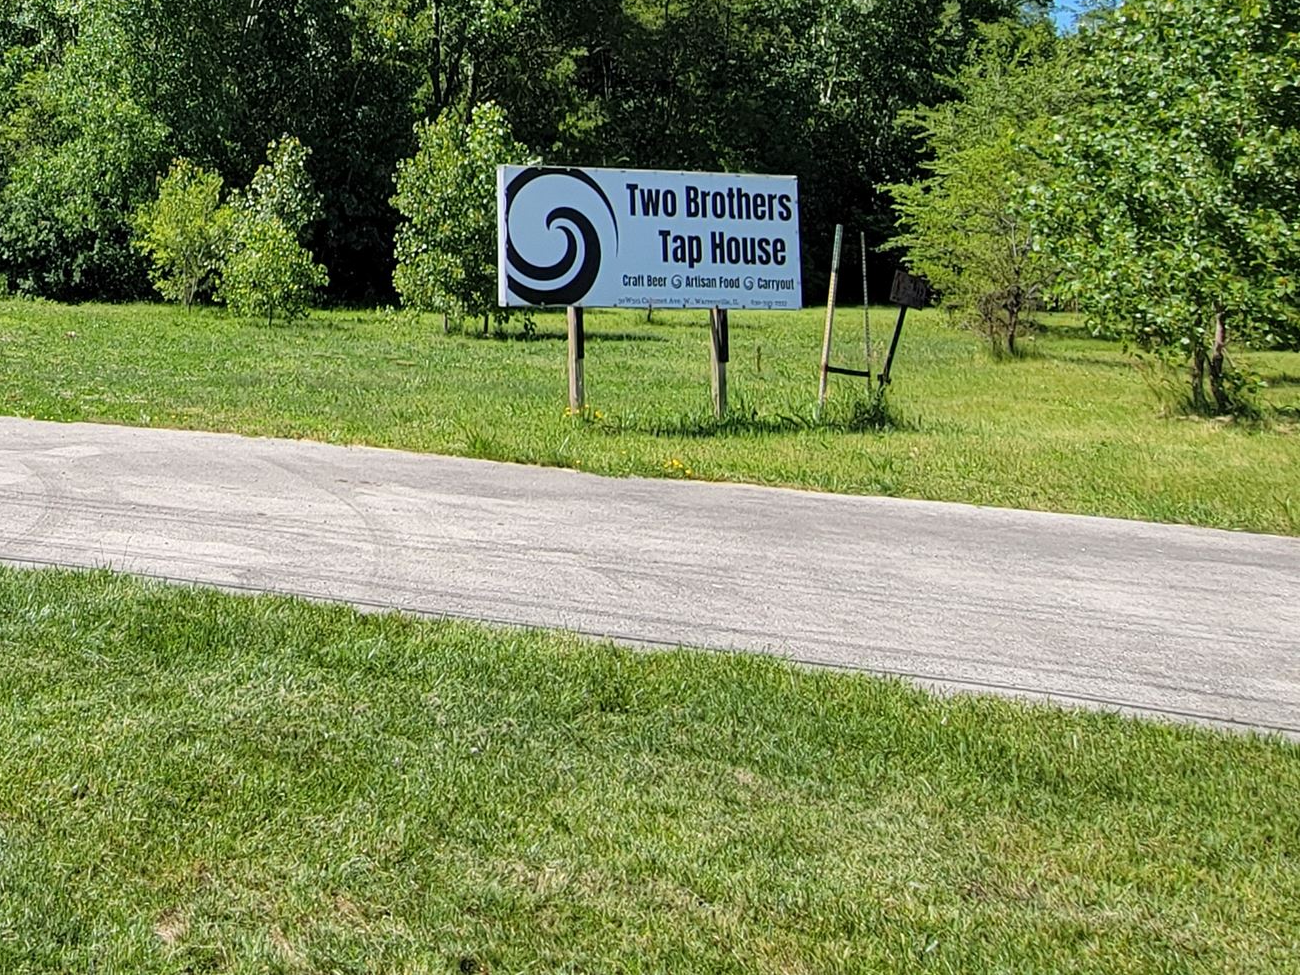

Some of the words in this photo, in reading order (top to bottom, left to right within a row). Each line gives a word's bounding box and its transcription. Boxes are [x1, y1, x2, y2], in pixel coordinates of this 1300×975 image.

[626, 183, 677, 218] Two
[685, 185, 792, 222] Brothers
[658, 230, 702, 269] Tap
[710, 231, 787, 266] House
[622, 274, 645, 287] Craft
[647, 275, 667, 287] Beer
[685, 276, 717, 288] Artisan
[719, 276, 740, 289] Food
[757, 278, 795, 291] Carryout
